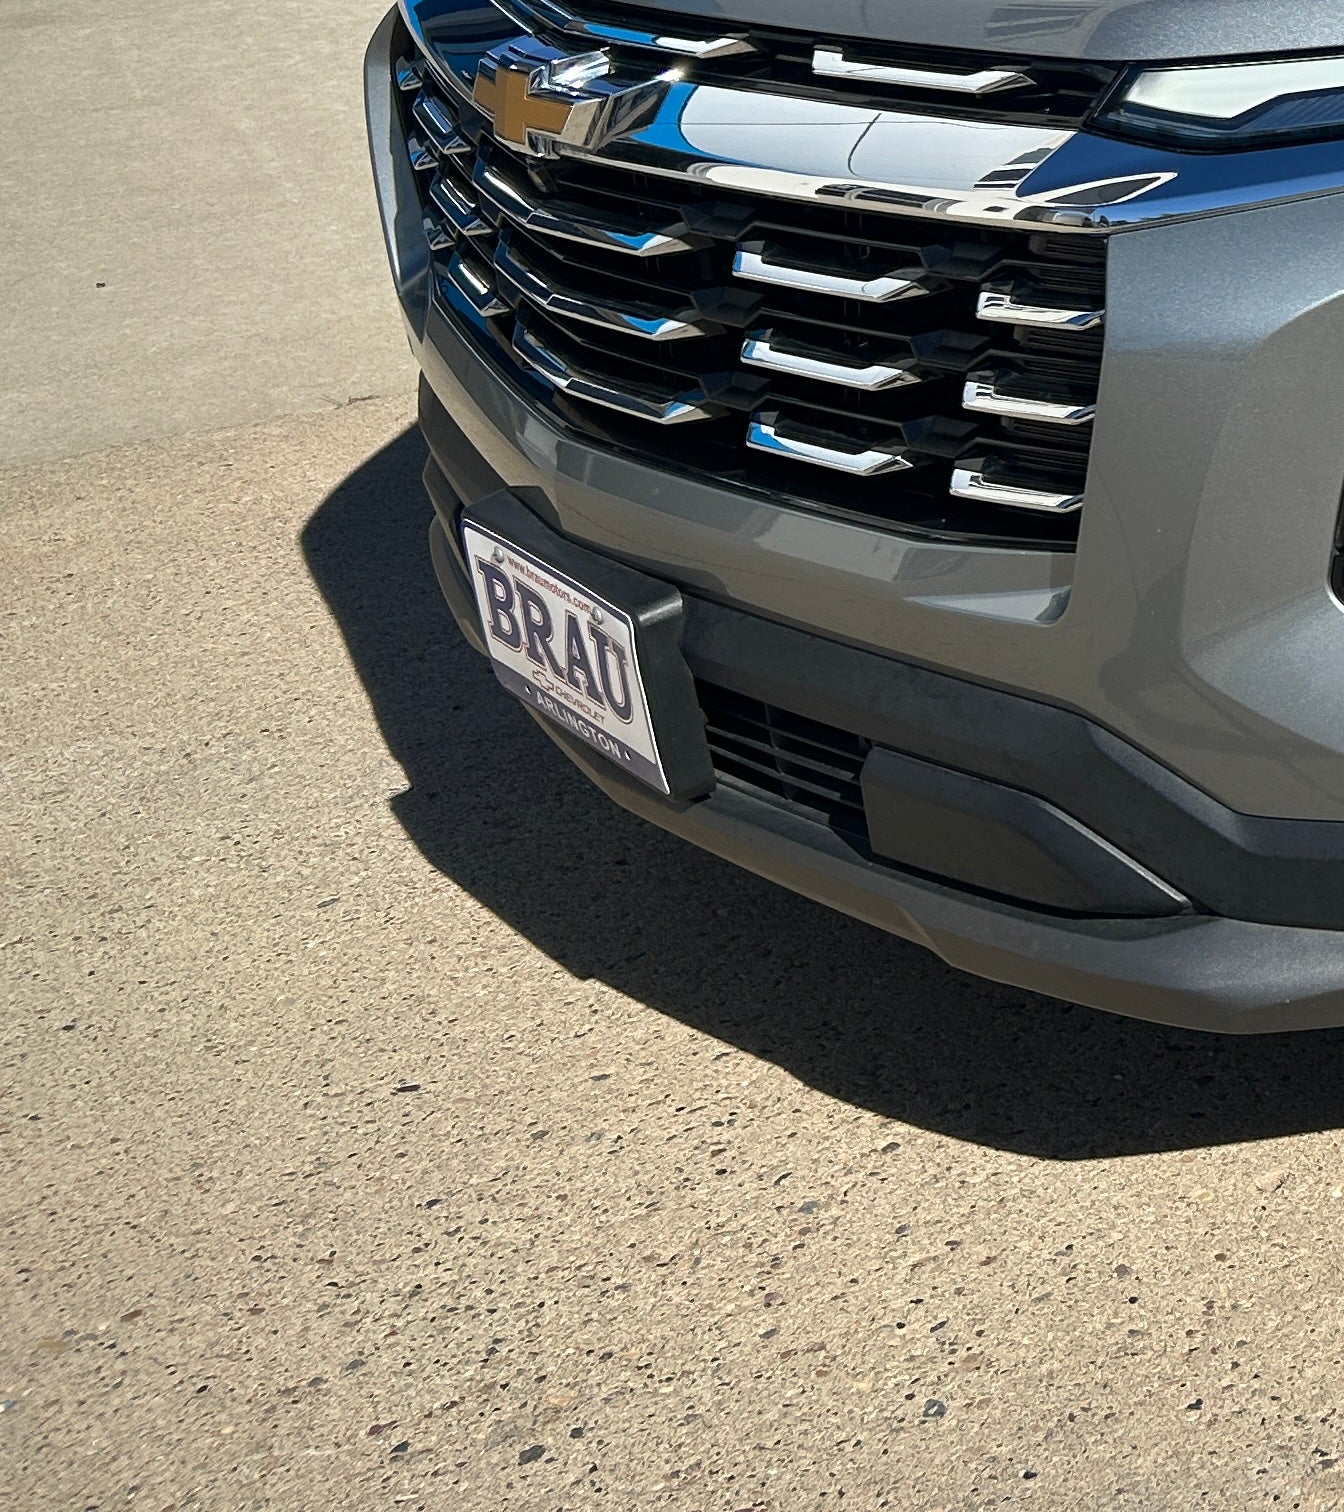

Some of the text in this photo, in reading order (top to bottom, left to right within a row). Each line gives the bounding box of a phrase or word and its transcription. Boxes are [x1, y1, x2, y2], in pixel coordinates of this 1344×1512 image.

[475, 554, 634, 725] BRAU
[536, 689, 623, 760] ARLINGTON
[554, 686, 606, 725] CHEVROLET
